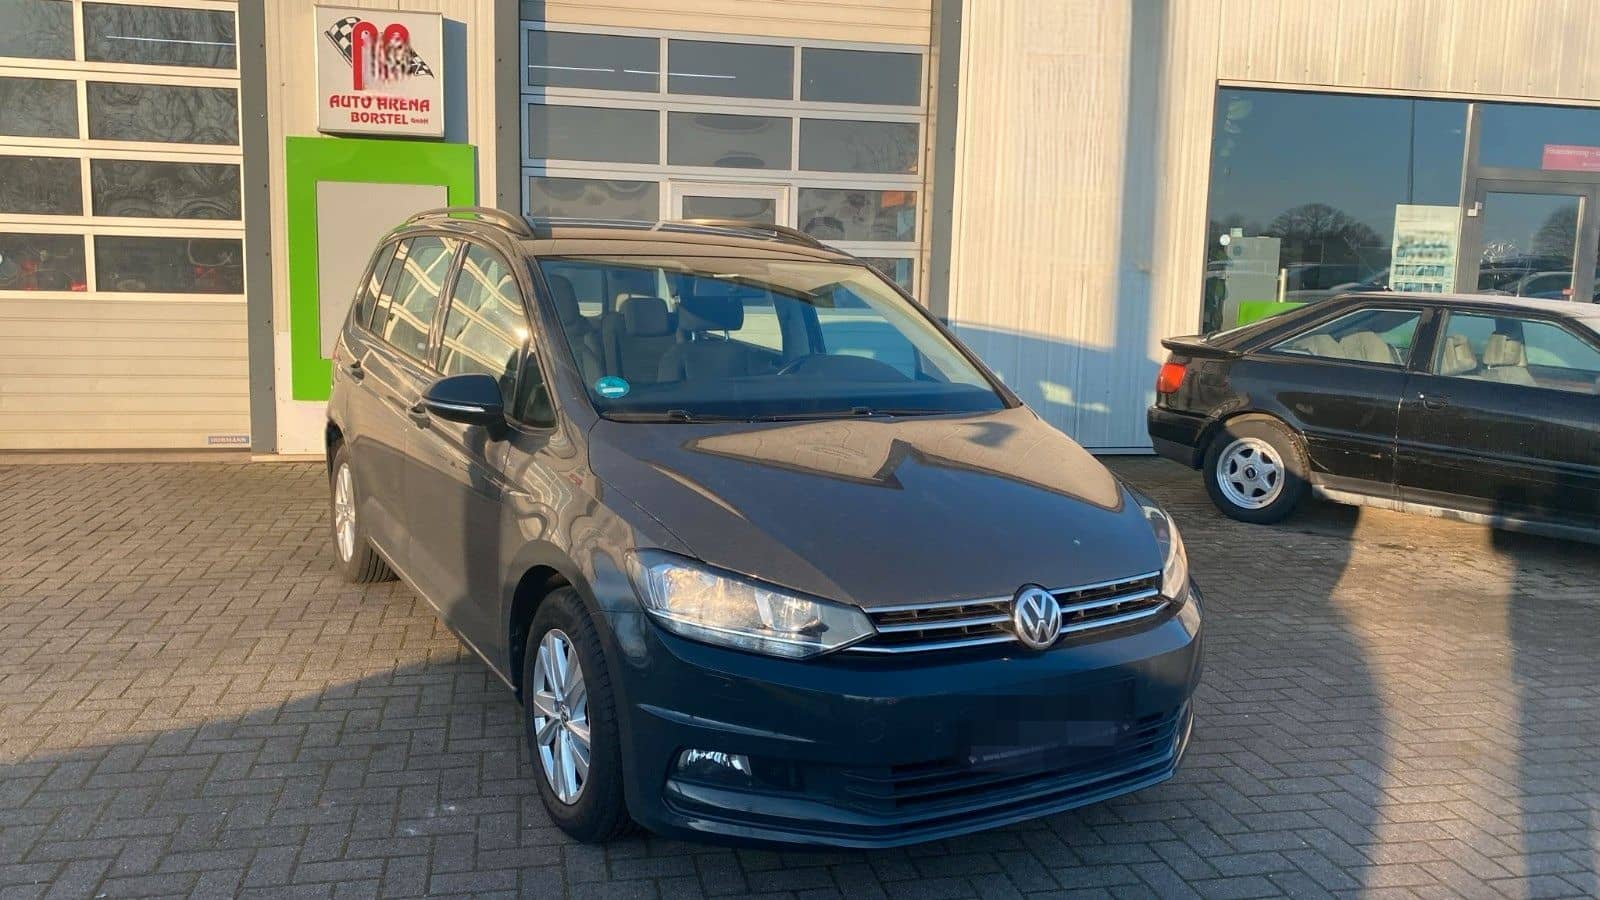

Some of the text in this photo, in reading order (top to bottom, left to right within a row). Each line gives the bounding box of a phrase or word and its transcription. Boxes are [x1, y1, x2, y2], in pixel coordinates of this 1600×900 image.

[329, 94, 430, 112] AUTO ARENA
[350, 111, 409, 125] BORSTEL
